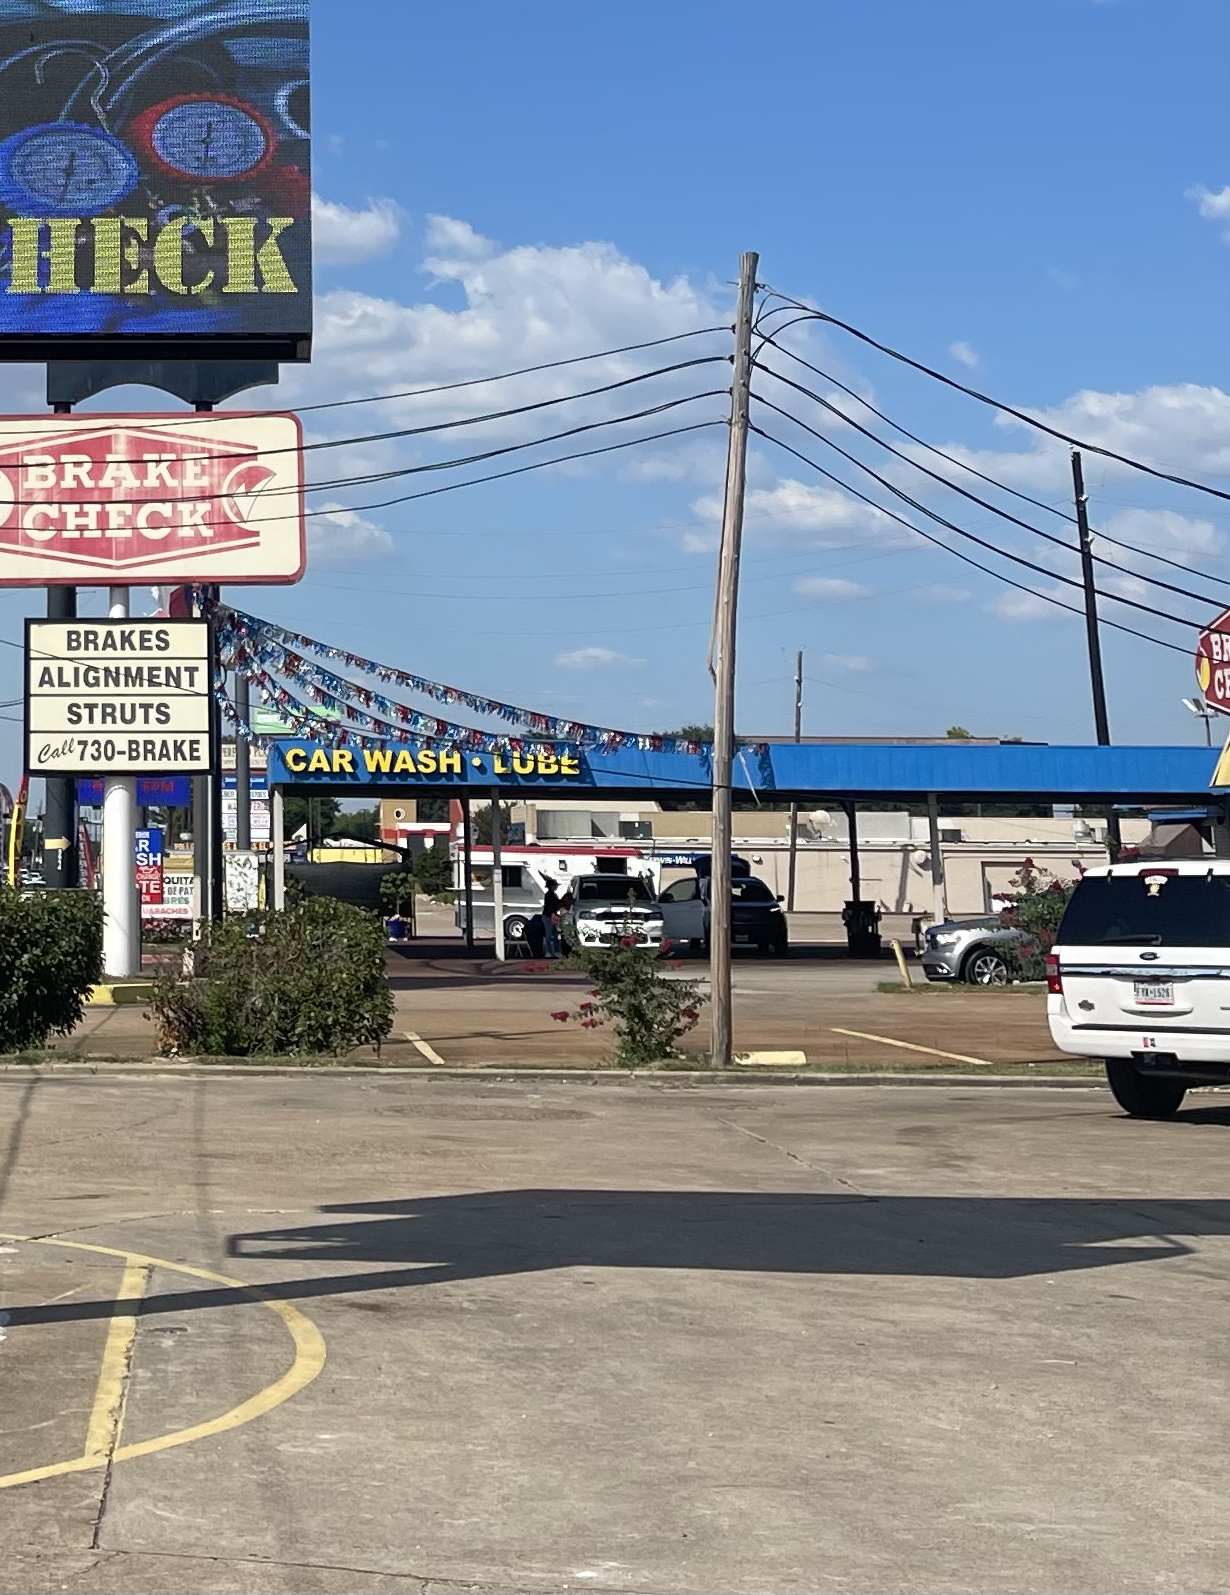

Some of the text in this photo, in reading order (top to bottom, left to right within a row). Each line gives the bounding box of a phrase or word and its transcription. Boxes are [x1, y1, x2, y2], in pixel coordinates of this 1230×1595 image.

[22, 453, 214, 542] BRAKE CHECK
[67, 629, 171, 652] BRAKES
[38, 666, 199, 689] ALIGNMENT
[67, 702, 171, 725] STRUTS
[37, 737, 75, 764] Call
[77, 739, 202, 762] 730-BRAKE
[285, 748, 354, 774] CAR
[363, 749, 462, 774] WASH
[493, 750, 580, 775] LUBE
